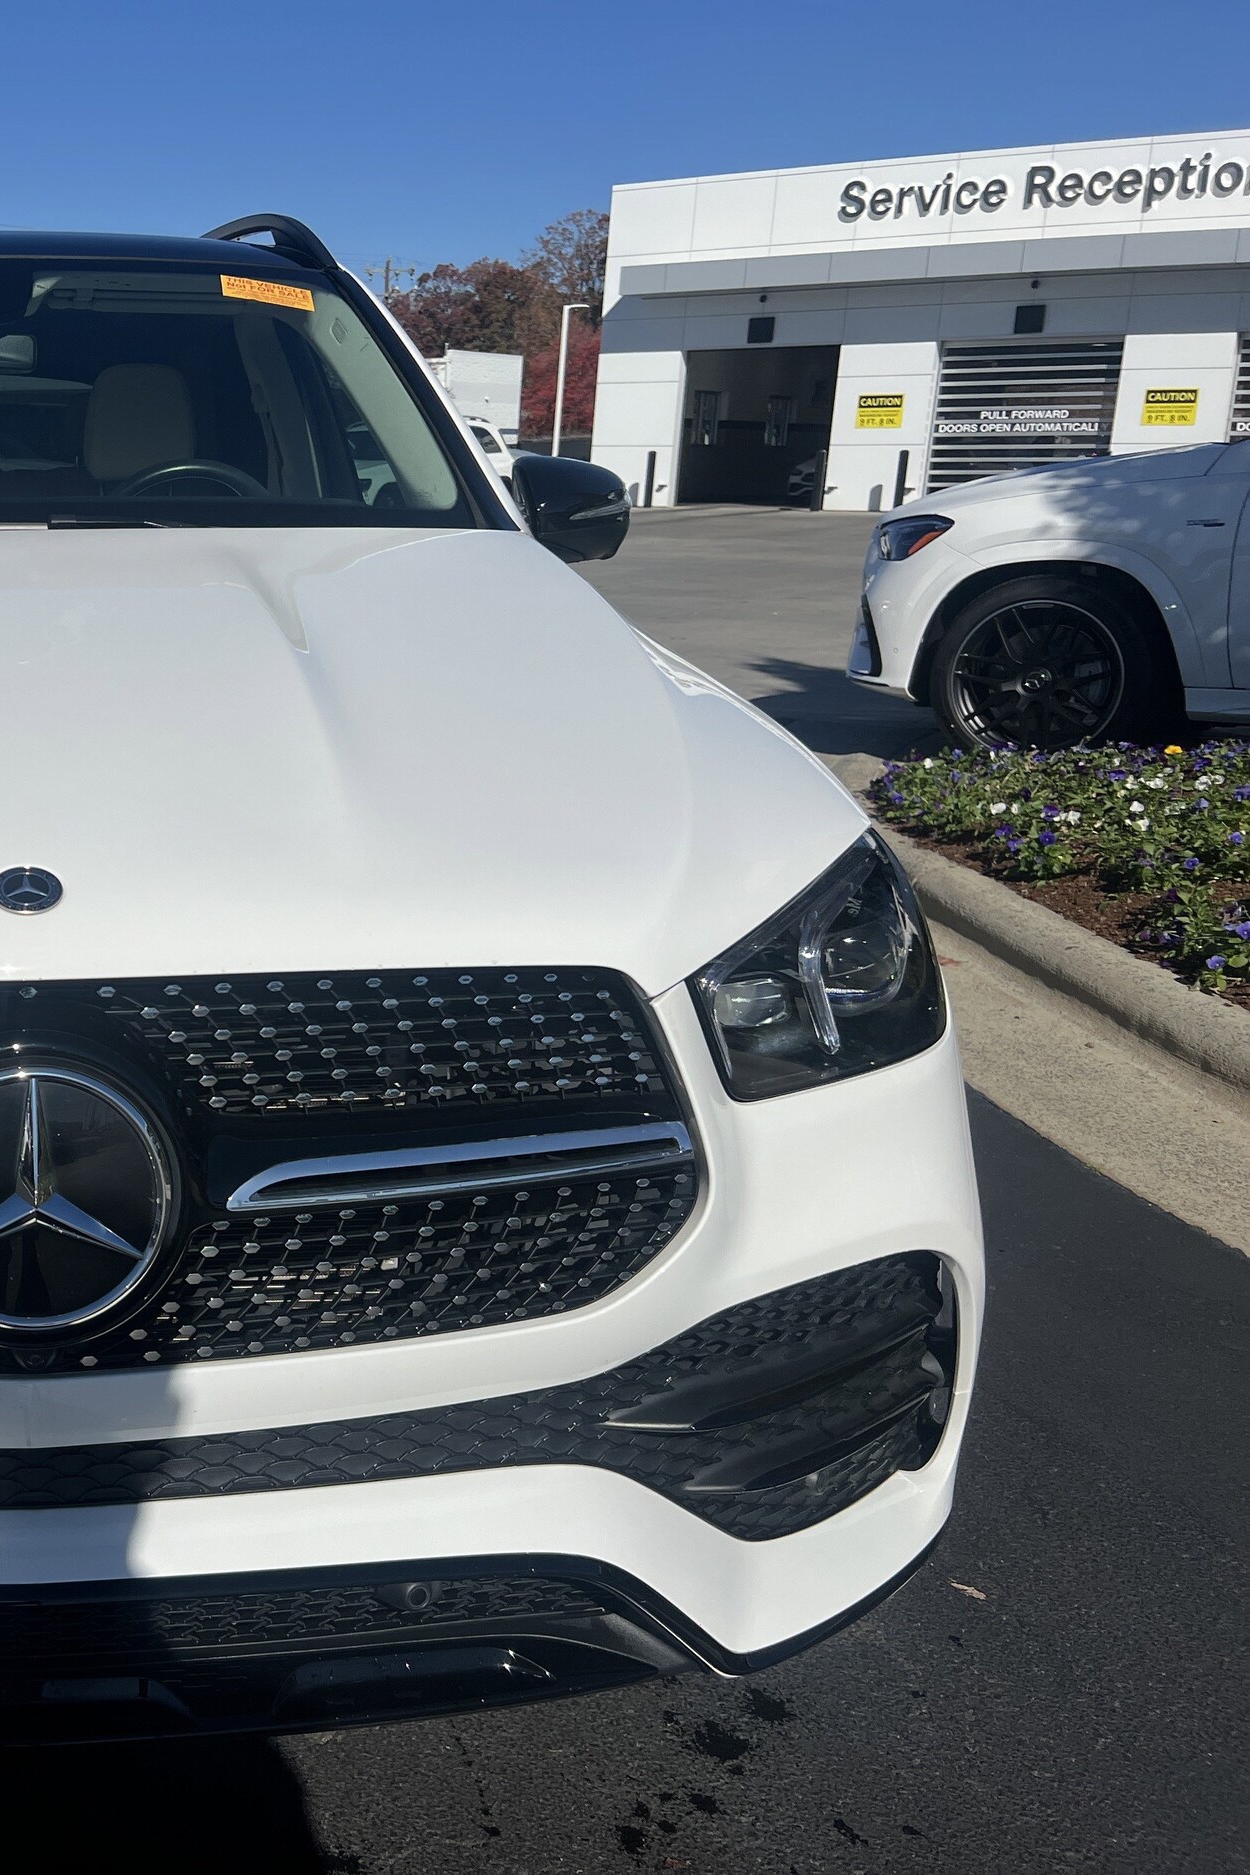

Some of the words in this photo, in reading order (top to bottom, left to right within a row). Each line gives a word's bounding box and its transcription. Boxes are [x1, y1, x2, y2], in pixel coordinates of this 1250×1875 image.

[839, 172, 1009, 221] Service
[1025, 151, 1250, 211] Receptio
[256, 282, 307, 295] VEHICLE
[278, 290, 309, 299] SALE
[1148, 392, 1196, 401] CAUTION
[860, 398, 901, 406] CAUTION
[980, 411, 1009, 420] PULL
[1011, 410, 1070, 419] FORWARD
[938, 424, 978, 433] DOORS
[979, 424, 1012, 432] OPEN
